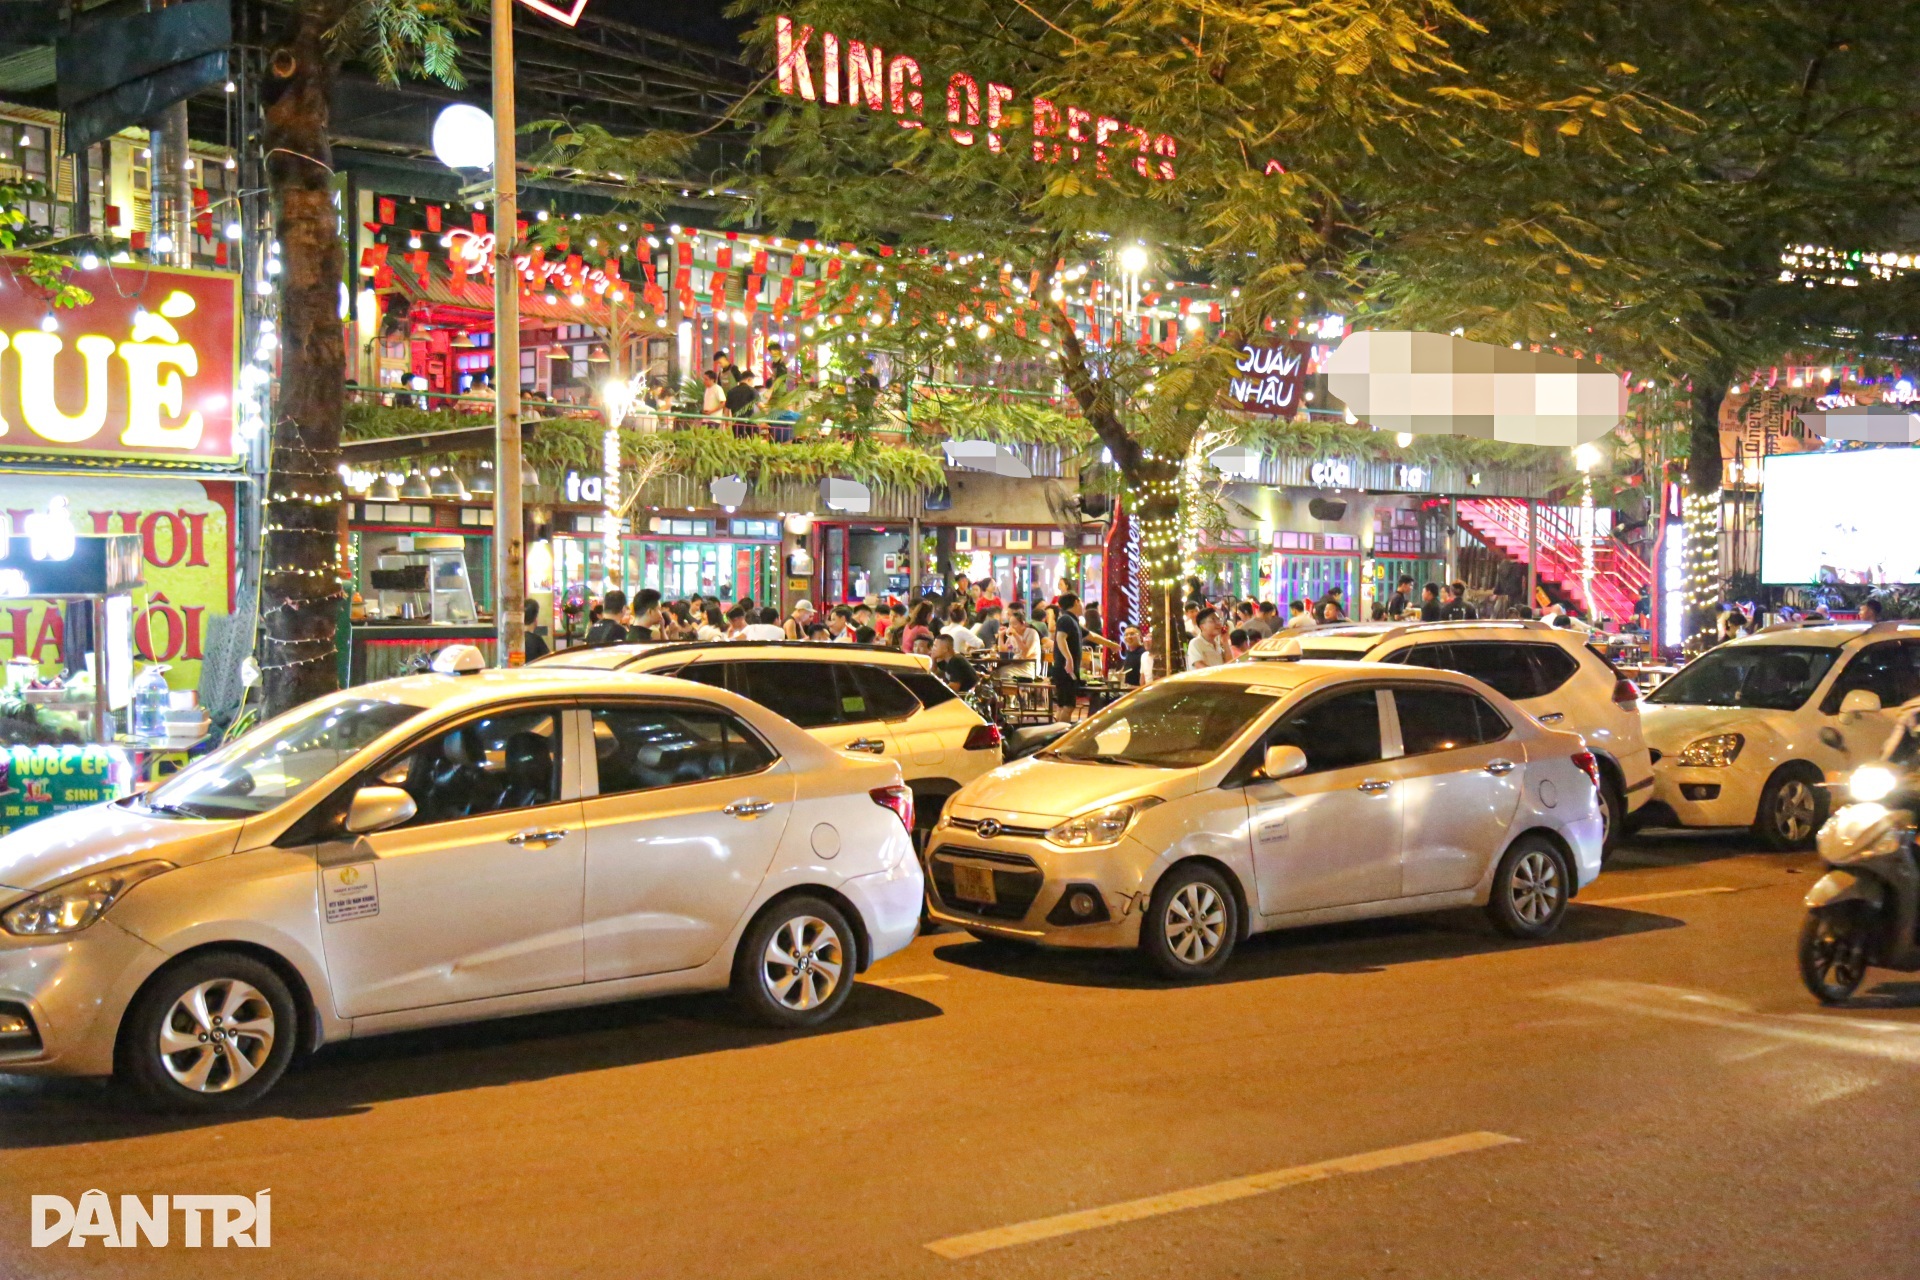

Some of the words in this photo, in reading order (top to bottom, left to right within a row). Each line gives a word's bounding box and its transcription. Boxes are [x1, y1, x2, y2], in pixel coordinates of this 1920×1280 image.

[776, 15, 923, 129] KING
[946, 71, 1013, 153] OF
[0, 291, 203, 450] UẾ
[1236, 345, 1302, 377] QUÁN
[1229, 376, 1294, 408] NHẬU
[566, 470, 602, 501] ta
[1311, 458, 1350, 490] của
[1399, 465, 1422, 488] ta
[65, 789, 98, 802] SINH
